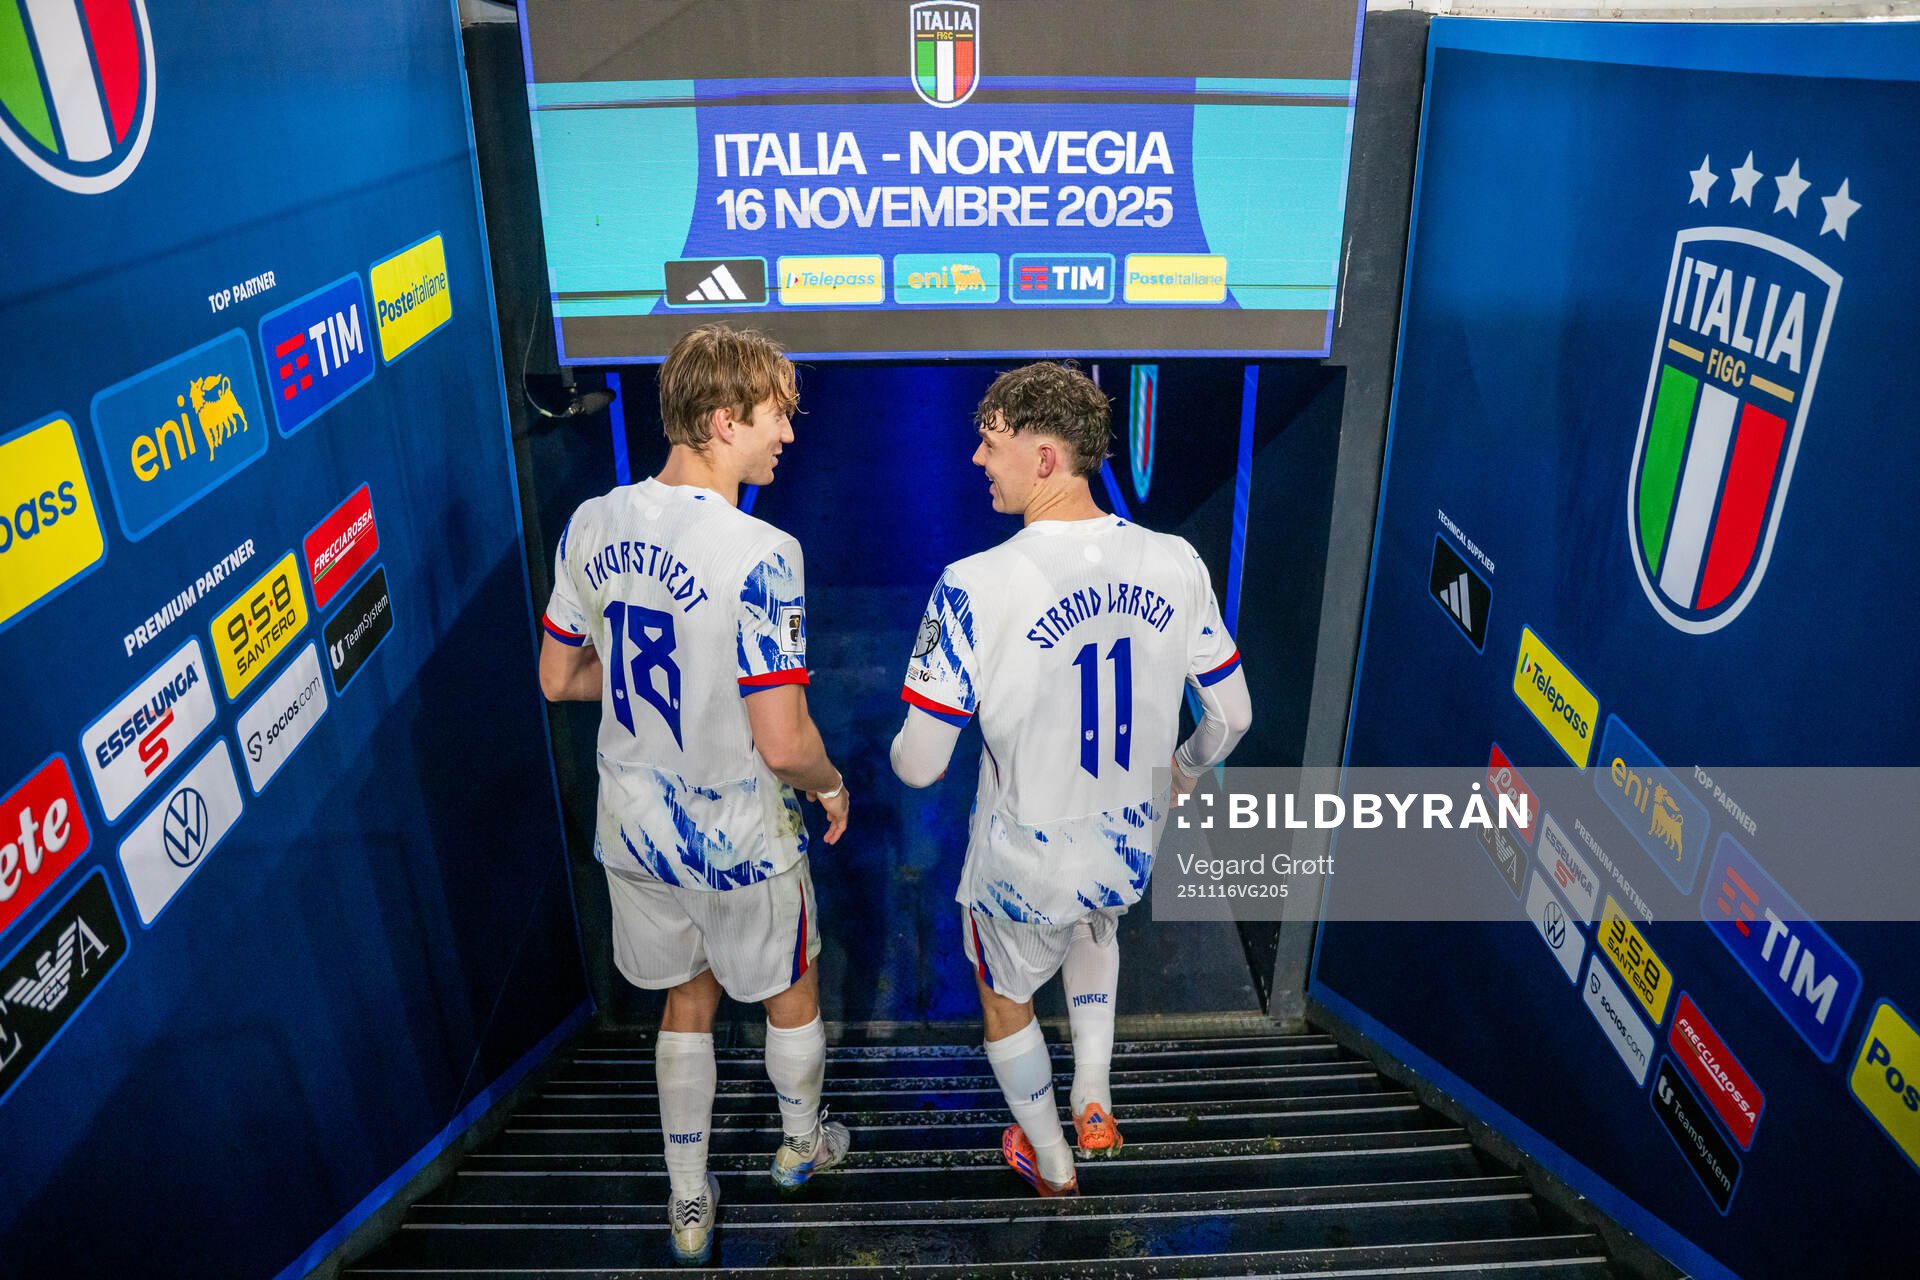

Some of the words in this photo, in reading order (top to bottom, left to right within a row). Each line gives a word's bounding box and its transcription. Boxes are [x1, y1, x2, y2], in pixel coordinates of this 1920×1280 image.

[916, 11, 973, 31] ITALIA
[714, 132, 867, 177] ITALIA
[910, 130, 1174, 175] NORVEGIA
[716, 188, 766, 230] 16
[775, 185, 1049, 230] NOVEMBRE
[1057, 185, 1174, 228] 2025
[208, 291, 231, 314] TOP
[233, 270, 276, 305] PARTNER
[377, 269, 446, 328] Posteitaliane
[801, 271, 875, 289] Telepass
[908, 266, 947, 289] eni
[1052, 266, 1104, 291] TIM
[308, 303, 364, 377] TIM
[1673, 256, 1807, 375] ITALIA
[1707, 347, 1746, 388] FIGC
[130, 394, 196, 482] eni
[314, 508, 373, 574] FRECCIAROSSA
[1438, 508, 1467, 546] TECHNICAL
[1467, 539, 1496, 575] SUPPLIER
[123, 586, 198, 657] PREMIUM
[196, 539, 256, 601] PARTNER
[584, 541, 709, 613] THORSTVEDT
[237, 608, 296, 677] SANTERO
[344, 594, 389, 650] TeamSystem
[1026, 586, 1102, 649] STRAND
[1107, 583, 1175, 633] LARSEN
[603, 600, 684, 752] 18
[1071, 636, 1132, 779] 11
[1531, 662, 1589, 739] Telepass
[95, 663, 199, 769] ESSELUNGA
[1611, 757, 1652, 814] eni
[1693, 765, 1713, 790] TOP
[1713, 785, 1758, 837] PARTNER
[1545, 826, 1594, 898] ESSELUNGA
[1574, 818, 1613, 875] PREMIUM
[1612, 867, 1654, 926] PARTNER
[1607, 935, 1655, 1006] SANTERO
[1760, 906, 1839, 1025] TIM
[1072, 993, 1108, 1008] NORGE
[1678, 1018, 1756, 1123] FRECCIAROSSA
[669, 1131, 703, 1145] NORGE
[1675, 1100, 1731, 1192] TeamSystem
